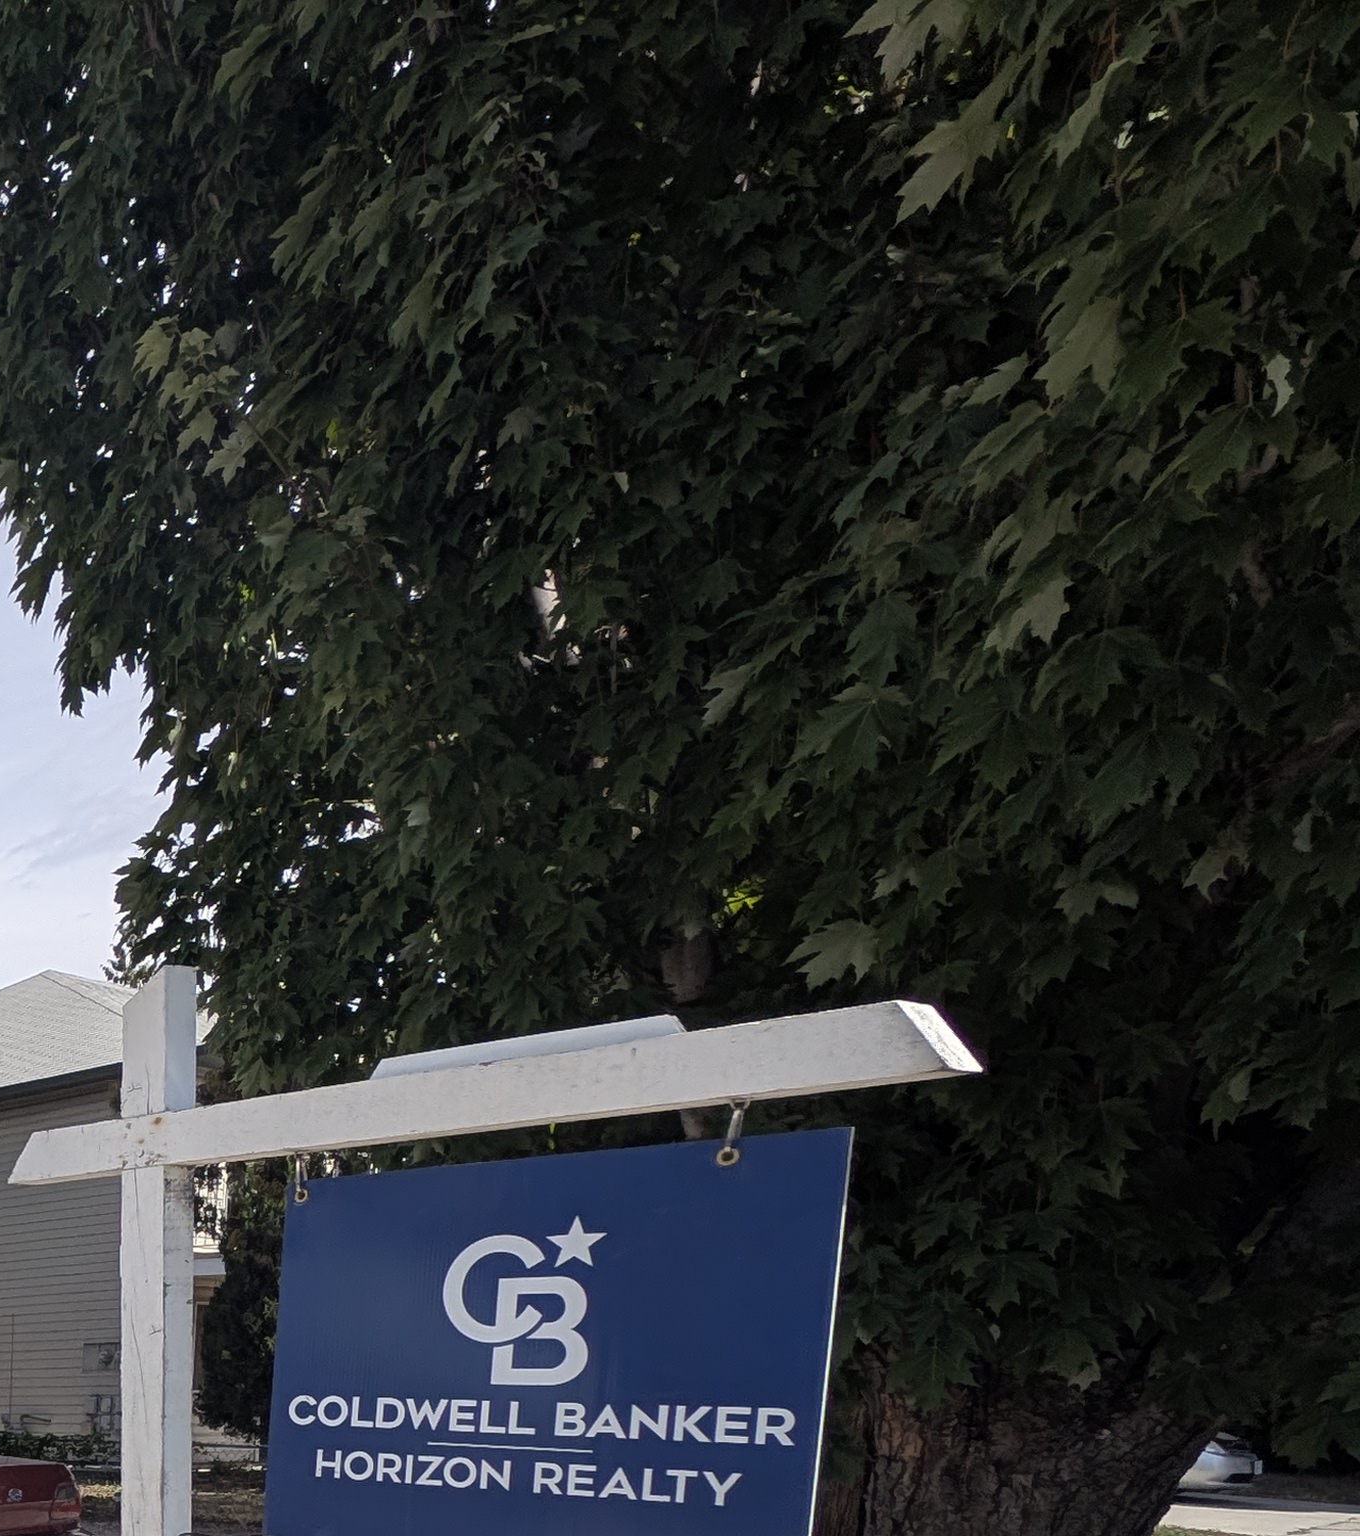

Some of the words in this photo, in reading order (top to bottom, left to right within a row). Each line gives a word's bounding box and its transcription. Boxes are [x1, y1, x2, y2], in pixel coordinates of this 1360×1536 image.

[443, 1234, 589, 1386] CB
[288, 1394, 536, 1435] COLDWELL
[554, 1402, 796, 1446] BANKER
[315, 1449, 511, 1491] HORIZON
[532, 1462, 742, 1506] REALTY
